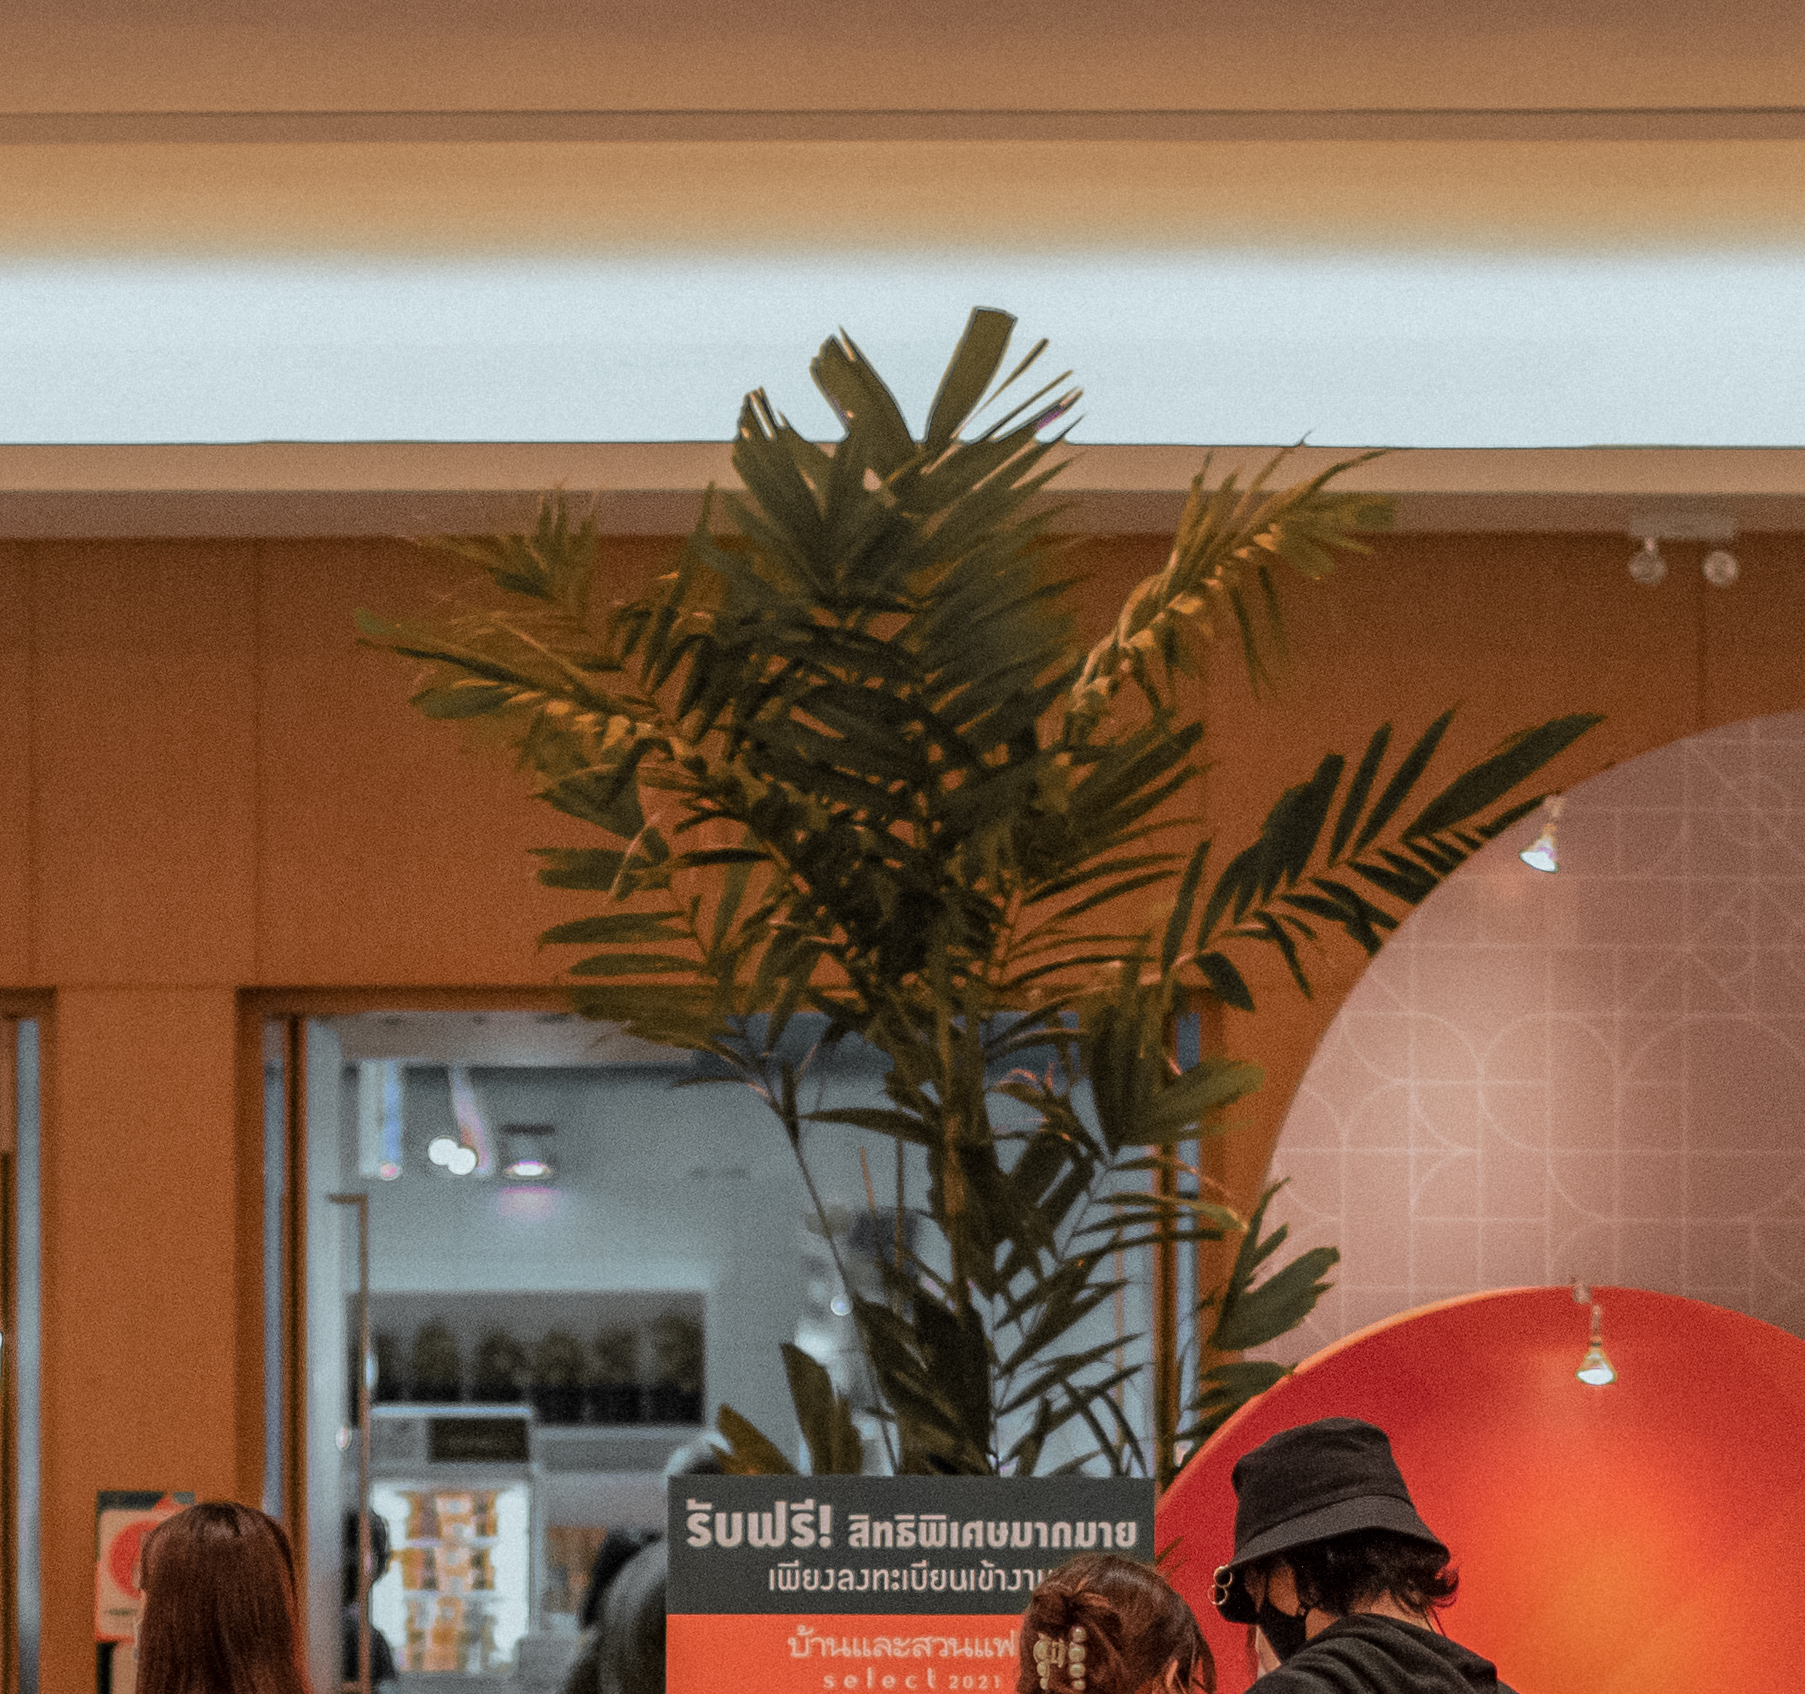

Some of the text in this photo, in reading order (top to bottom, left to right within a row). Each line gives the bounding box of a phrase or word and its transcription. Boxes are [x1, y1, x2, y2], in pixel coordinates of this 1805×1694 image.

[686, 1498, 1137, 1549] รับฟรี! สิทธิพิเศษมากมาย
[788, 1624, 1019, 1659] บ้านและสวนแฟ
[823, 1667, 1001, 1690] select 2021
